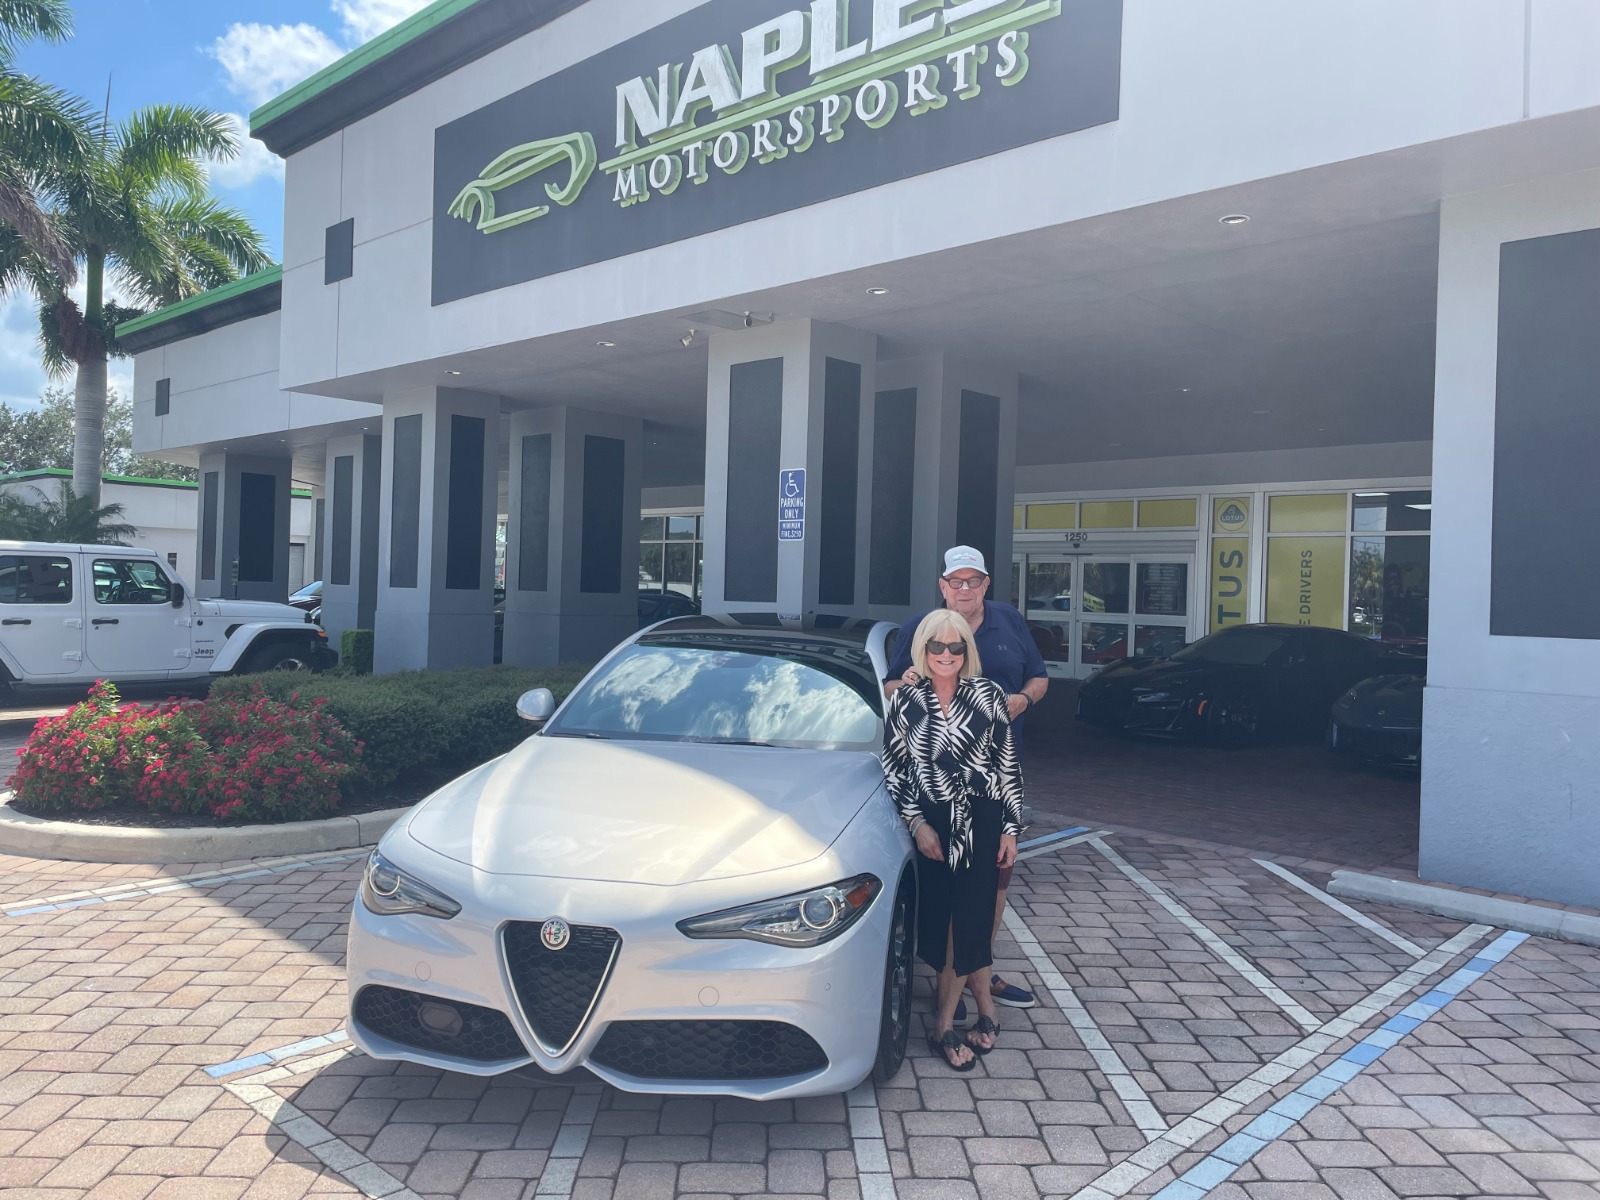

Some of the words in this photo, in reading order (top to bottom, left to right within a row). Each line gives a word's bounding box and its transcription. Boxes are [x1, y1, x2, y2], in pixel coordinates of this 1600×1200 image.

[615, 0, 1012, 149] NAPLE
[613, 31, 1020, 203] MOTORSPORTS
[780, 498, 804, 507] PARKING
[784, 509, 799, 519] ONLY
[1064, 532, 1088, 542] 1250
[1218, 549, 1243, 624] TUS
[1299, 550, 1313, 614] DRIVERS
